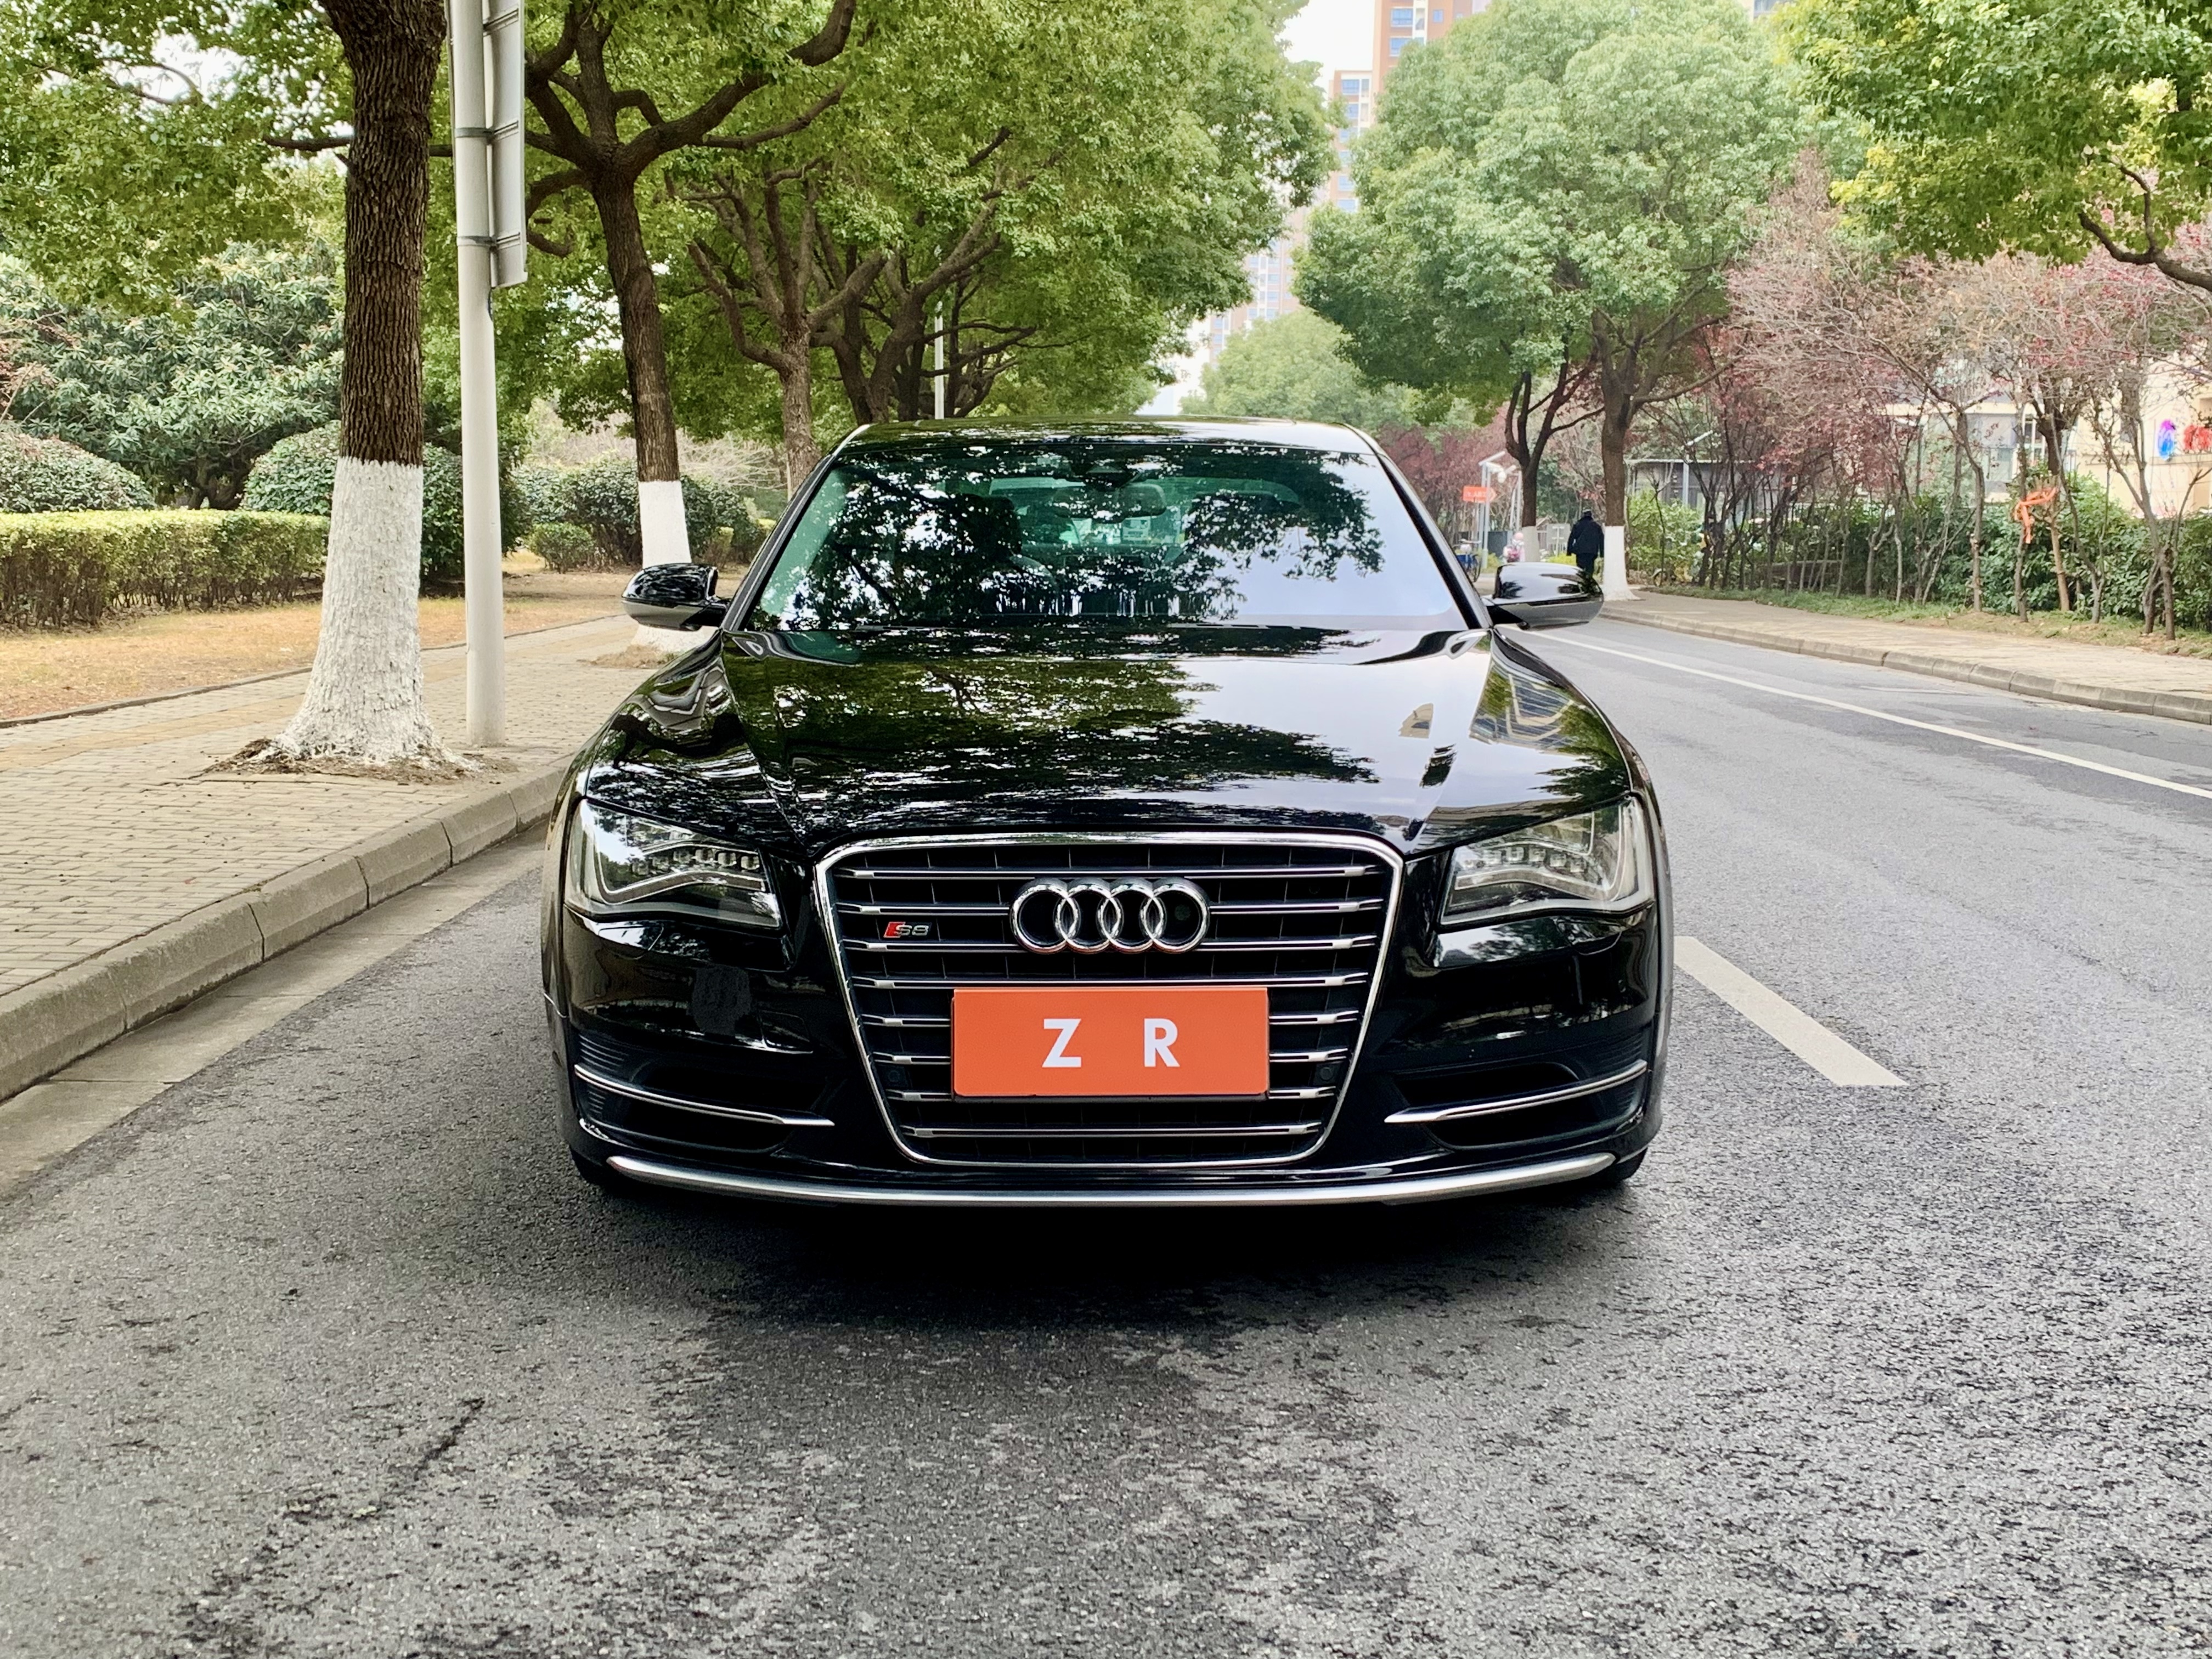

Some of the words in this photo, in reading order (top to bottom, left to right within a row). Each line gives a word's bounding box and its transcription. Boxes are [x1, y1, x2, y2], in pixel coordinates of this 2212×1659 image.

[894, 924, 930, 936] S8
[1042, 1018, 1082, 1068] Z
[1143, 1018, 1180, 1068] R
